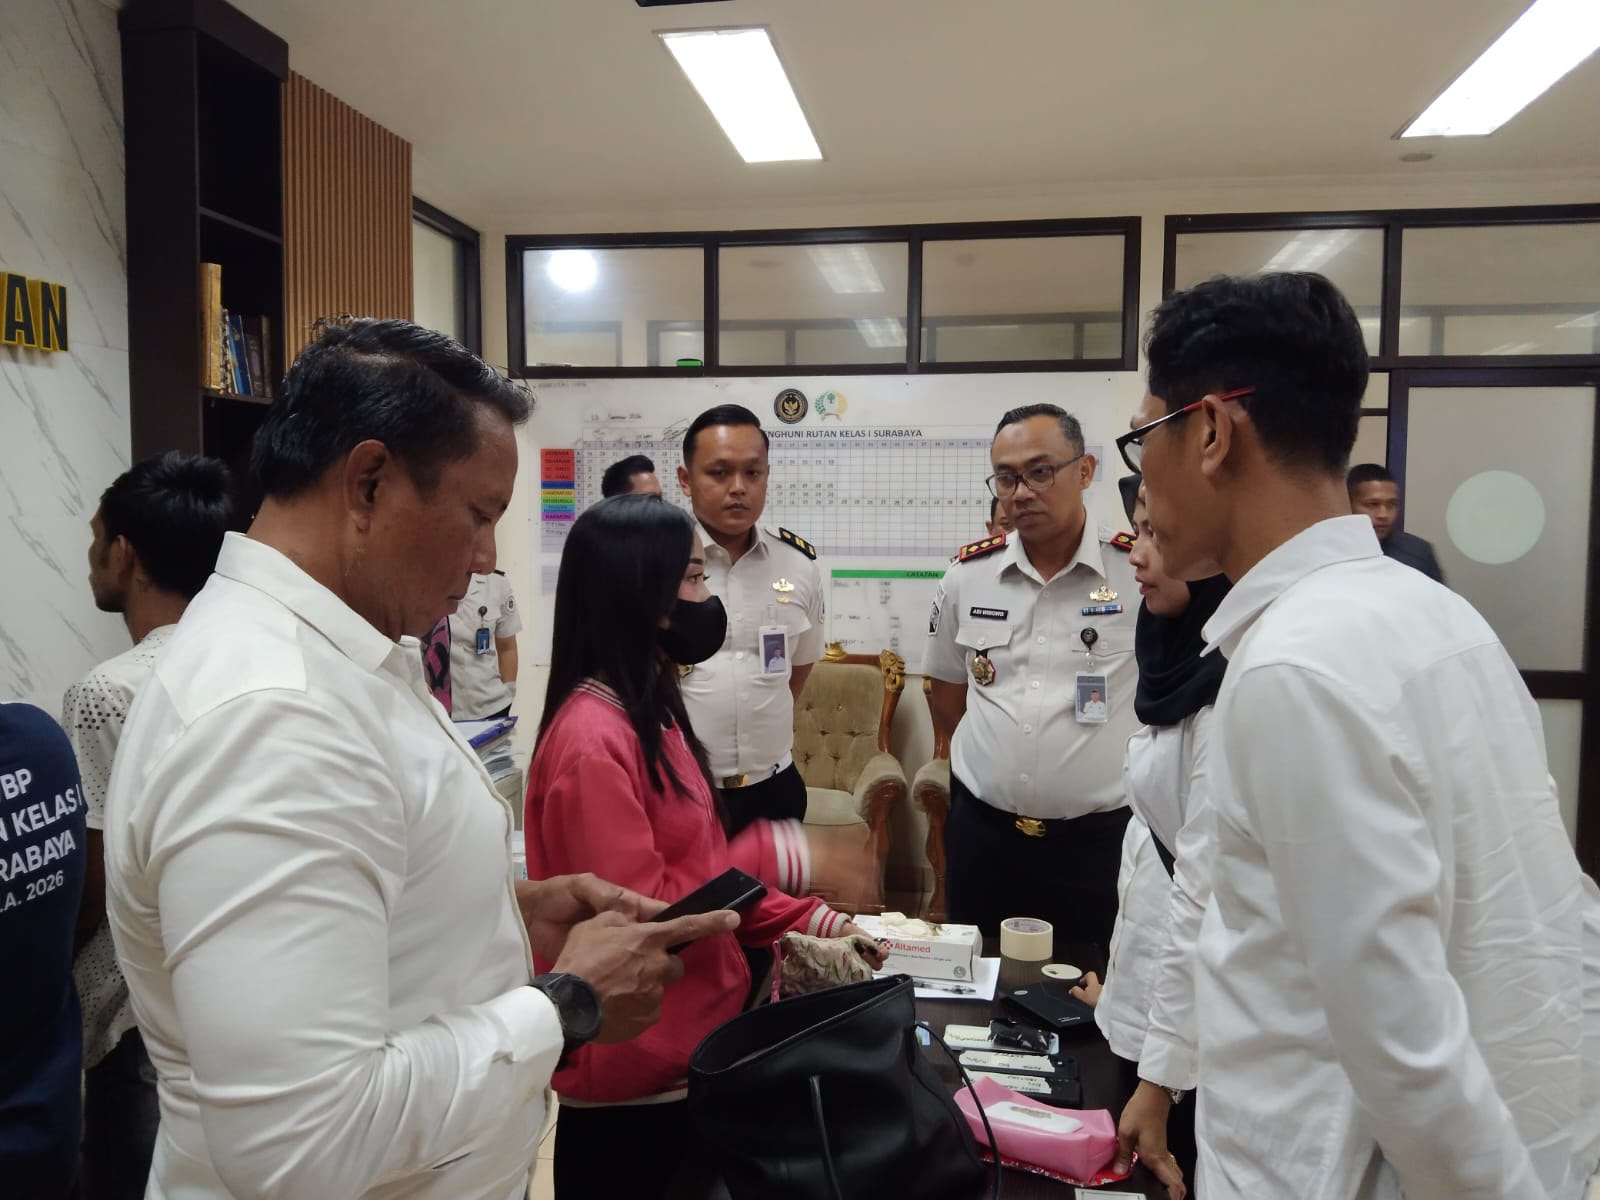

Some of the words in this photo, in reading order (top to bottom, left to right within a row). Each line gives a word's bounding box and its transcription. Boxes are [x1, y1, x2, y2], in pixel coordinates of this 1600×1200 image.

[2, 272, 68, 352] AN
[766, 430, 804, 438] NGHUNI
[806, 430, 837, 438] RUTAN
[840, 430, 866, 438] KELAS
[873, 429, 922, 438] SURABAYA
[11, 788, 77, 837] KELAS
[75, 783, 83, 806] I
[0, 829, 77, 882] RABAYA
[26, 869, 64, 901] 2026
[895, 942, 931, 951] Altamed
